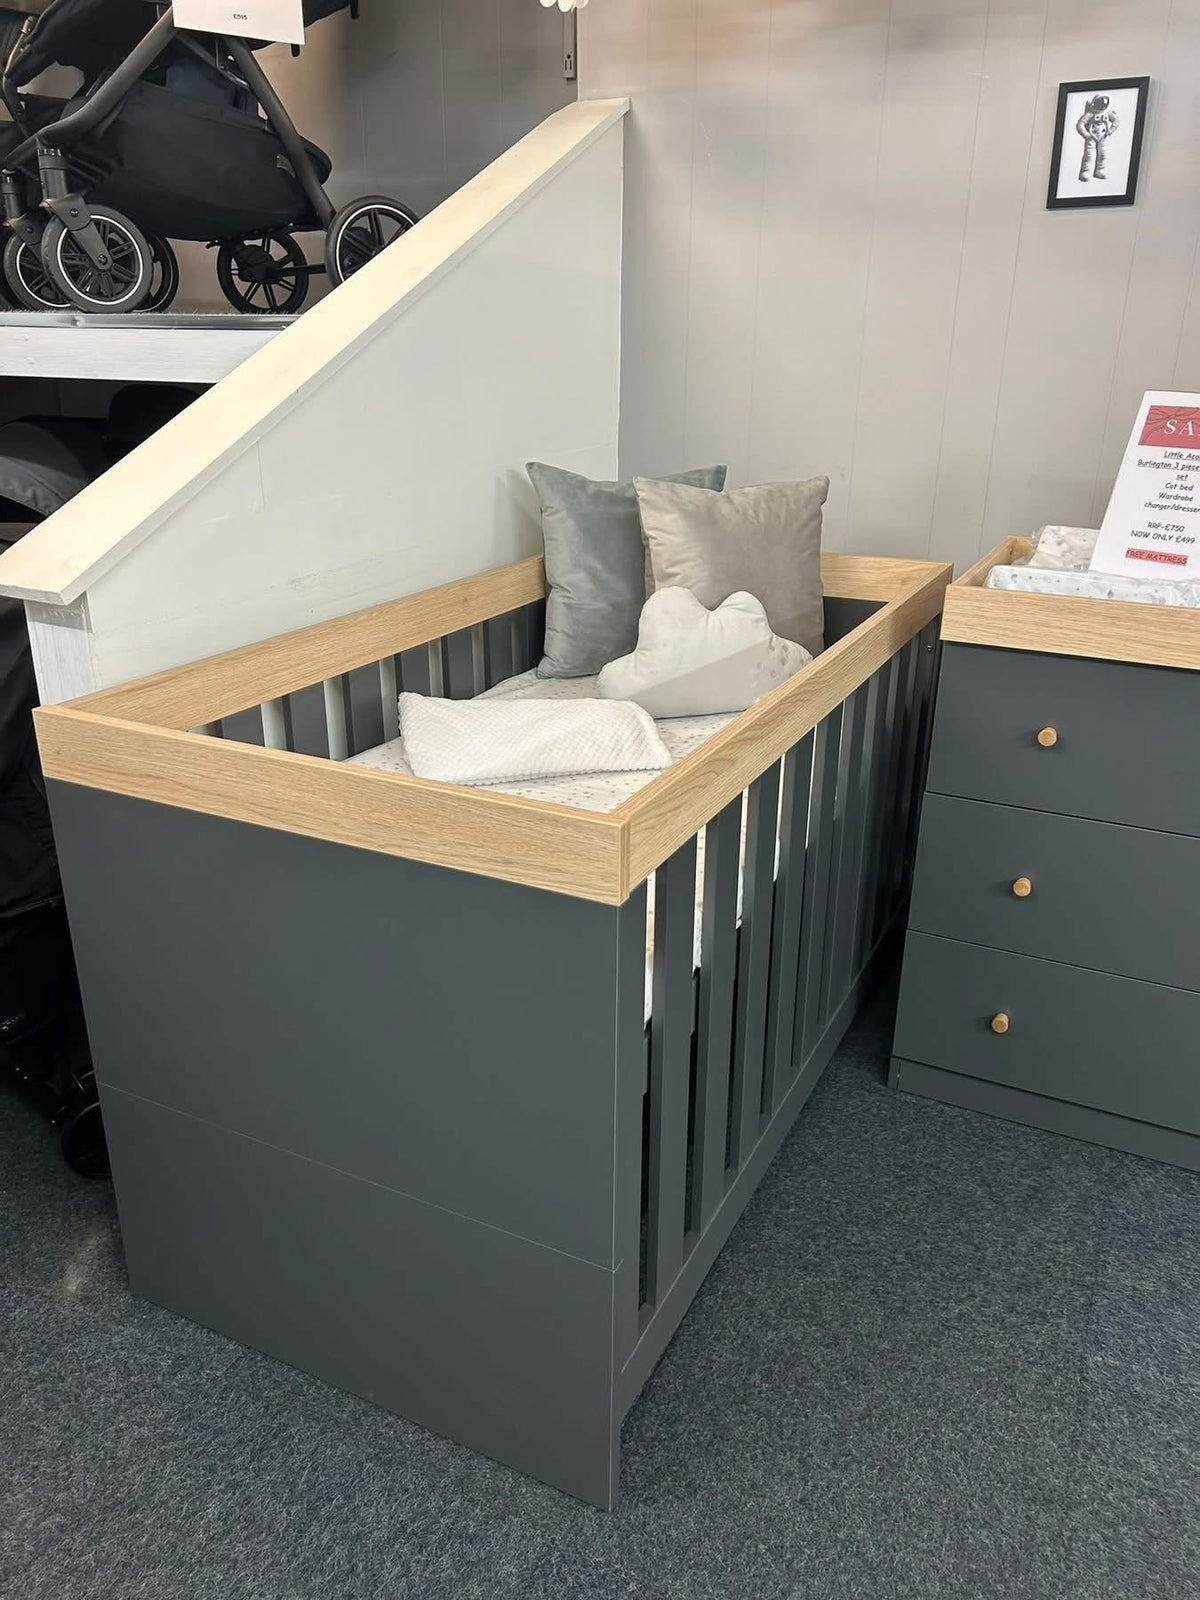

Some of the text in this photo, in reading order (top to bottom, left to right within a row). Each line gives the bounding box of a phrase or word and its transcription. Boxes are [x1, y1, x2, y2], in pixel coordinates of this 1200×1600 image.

[1163, 419, 1200, 436] SA
[1163, 450, 1184, 459] Little
[1137, 459, 1172, 469] Burlington
[1158, 492, 1194, 502] Wardrobe
[1147, 521, 1185, 532] RRP-£750
[1130, 530, 1196, 544] NOW ONLY £499
[1126, 550, 1187, 564] FREE MATTRESS
